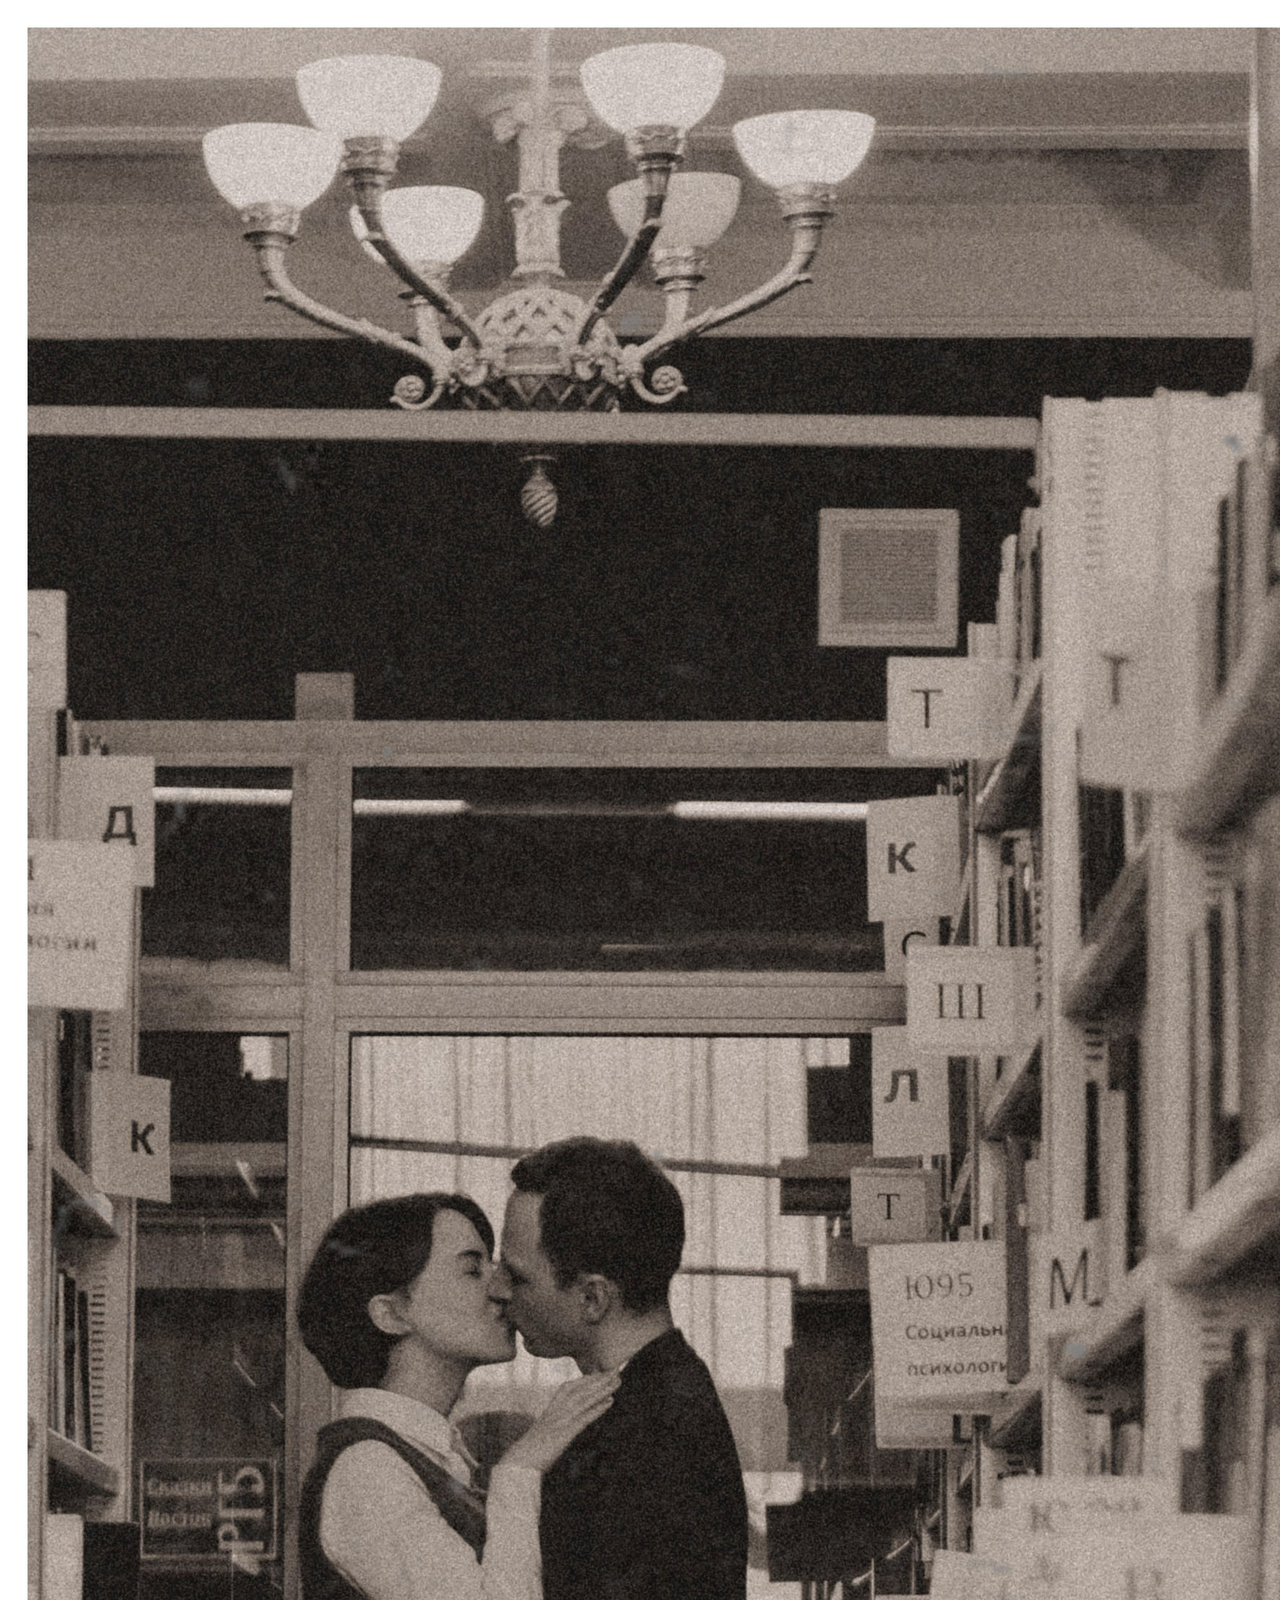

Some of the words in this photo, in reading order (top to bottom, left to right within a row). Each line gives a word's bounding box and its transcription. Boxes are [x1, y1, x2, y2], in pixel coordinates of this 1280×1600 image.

[102, 806, 137, 846] Д
[887, 842, 917, 874] К
[937, 983, 986, 1020] Ш
[884, 1068, 919, 1103] Л
[130, 1120, 156, 1156] К
[877, 1193, 901, 1221] Т
[905, 1272, 975, 1301] Ю95
